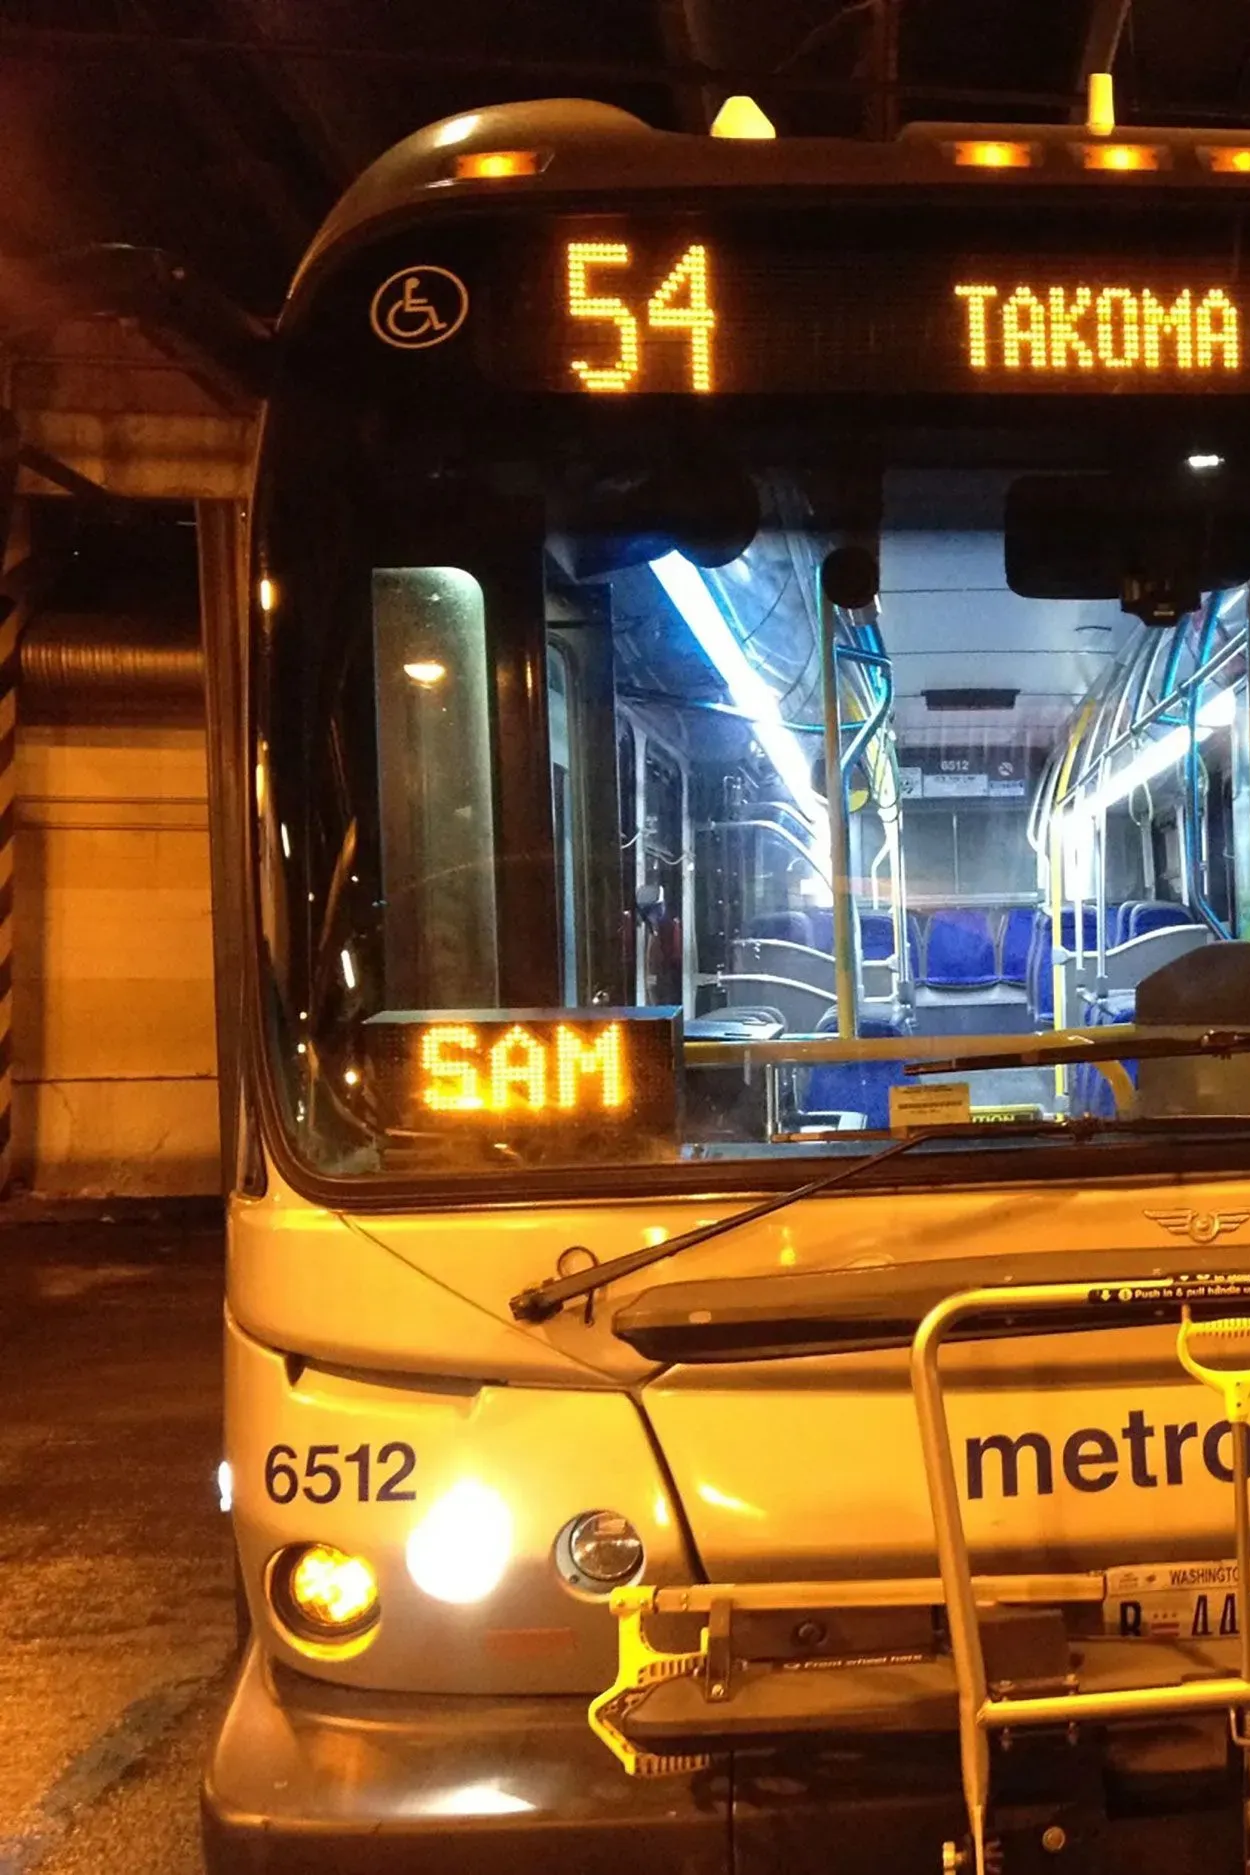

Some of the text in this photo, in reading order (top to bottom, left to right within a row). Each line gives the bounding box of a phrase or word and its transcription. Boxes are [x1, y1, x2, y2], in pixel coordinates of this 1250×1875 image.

[567, 243, 715, 392] 54
[955, 285, 1238, 369] TAKOMA
[421, 1022, 623, 1112] SAM
[265, 1441, 416, 1504] 6512
[1170, 1566, 1249, 1585] WASHINGTO
